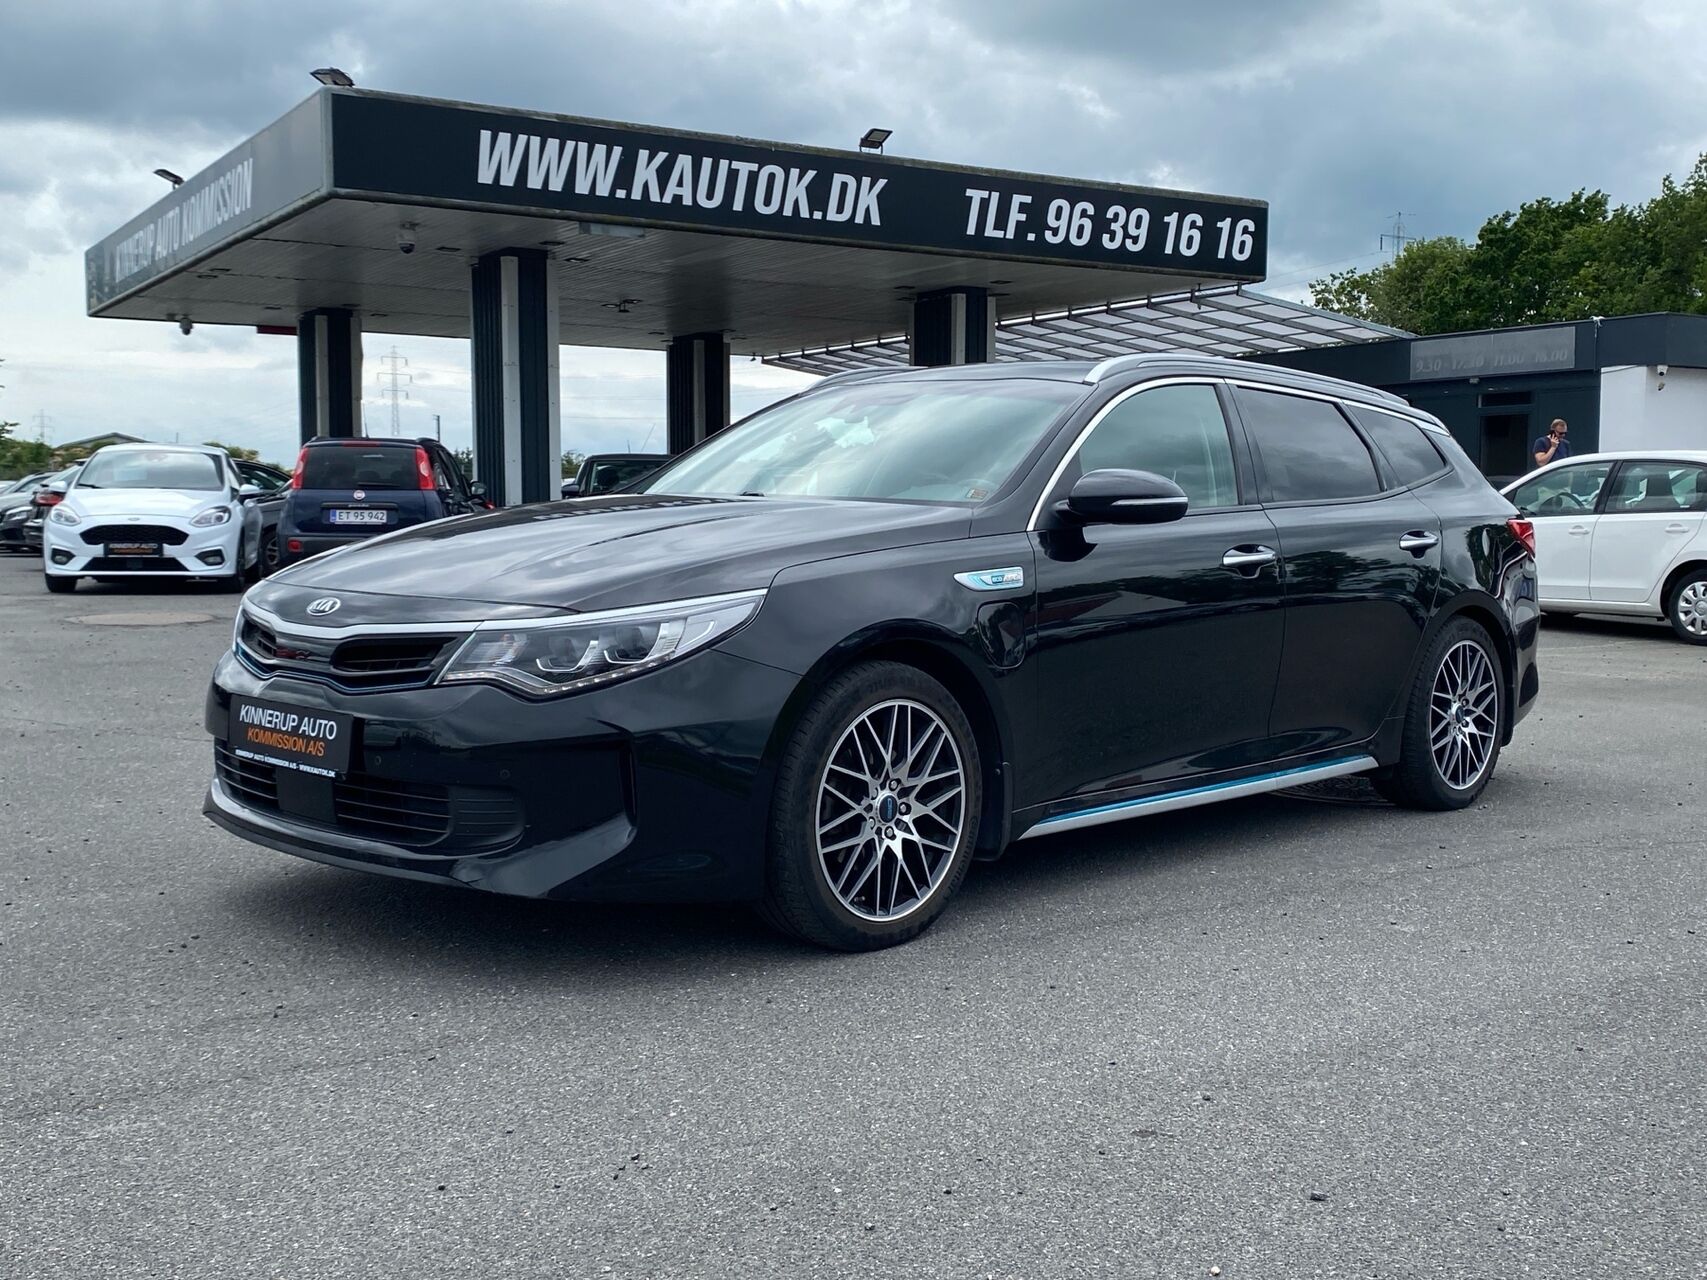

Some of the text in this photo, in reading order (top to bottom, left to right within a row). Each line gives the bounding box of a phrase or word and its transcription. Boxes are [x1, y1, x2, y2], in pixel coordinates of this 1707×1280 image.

[477, 129, 888, 225] WWW.KAUTOK.DK
[155, 206, 180, 261] AUTO
[181, 158, 253, 247] KOMMISSION
[965, 188, 1256, 262] TLF. 96 39 16 16
[338, 511, 385, 520] ET 95 942
[309, 598, 337, 613] KIA
[240, 704, 337, 740] KINNERUP AUTO
[247, 727, 325, 757] KOMMISSION A/S
